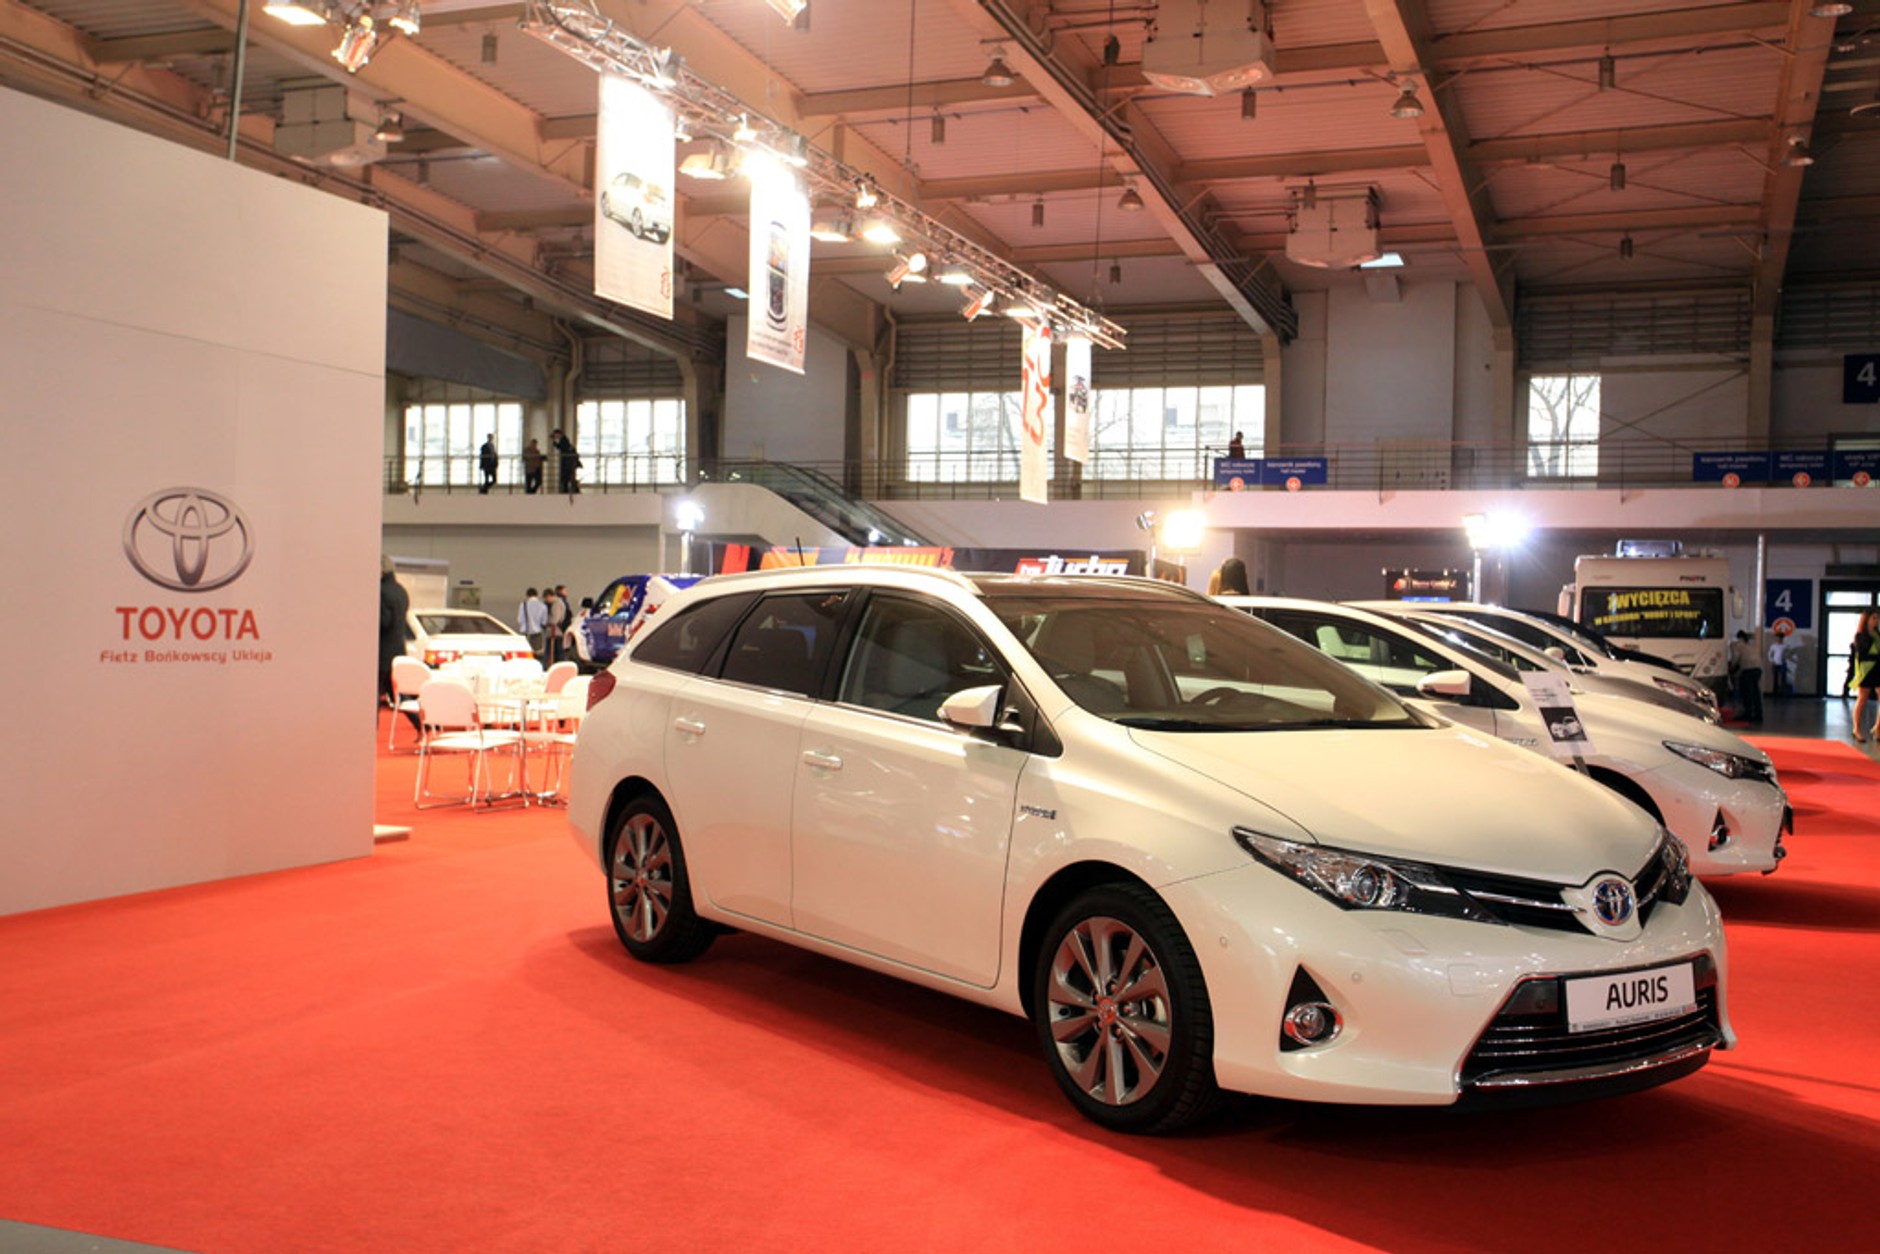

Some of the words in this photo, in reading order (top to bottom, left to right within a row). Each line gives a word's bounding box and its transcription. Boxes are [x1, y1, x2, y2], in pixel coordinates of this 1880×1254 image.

[1856, 361, 1877, 387] 4
[1607, 590, 1691, 611] ZWYCIĘZCA
[1775, 589, 1793, 612] 4
[115, 606, 260, 641] TOYOTA
[1606, 976, 1669, 1011] AURIS
